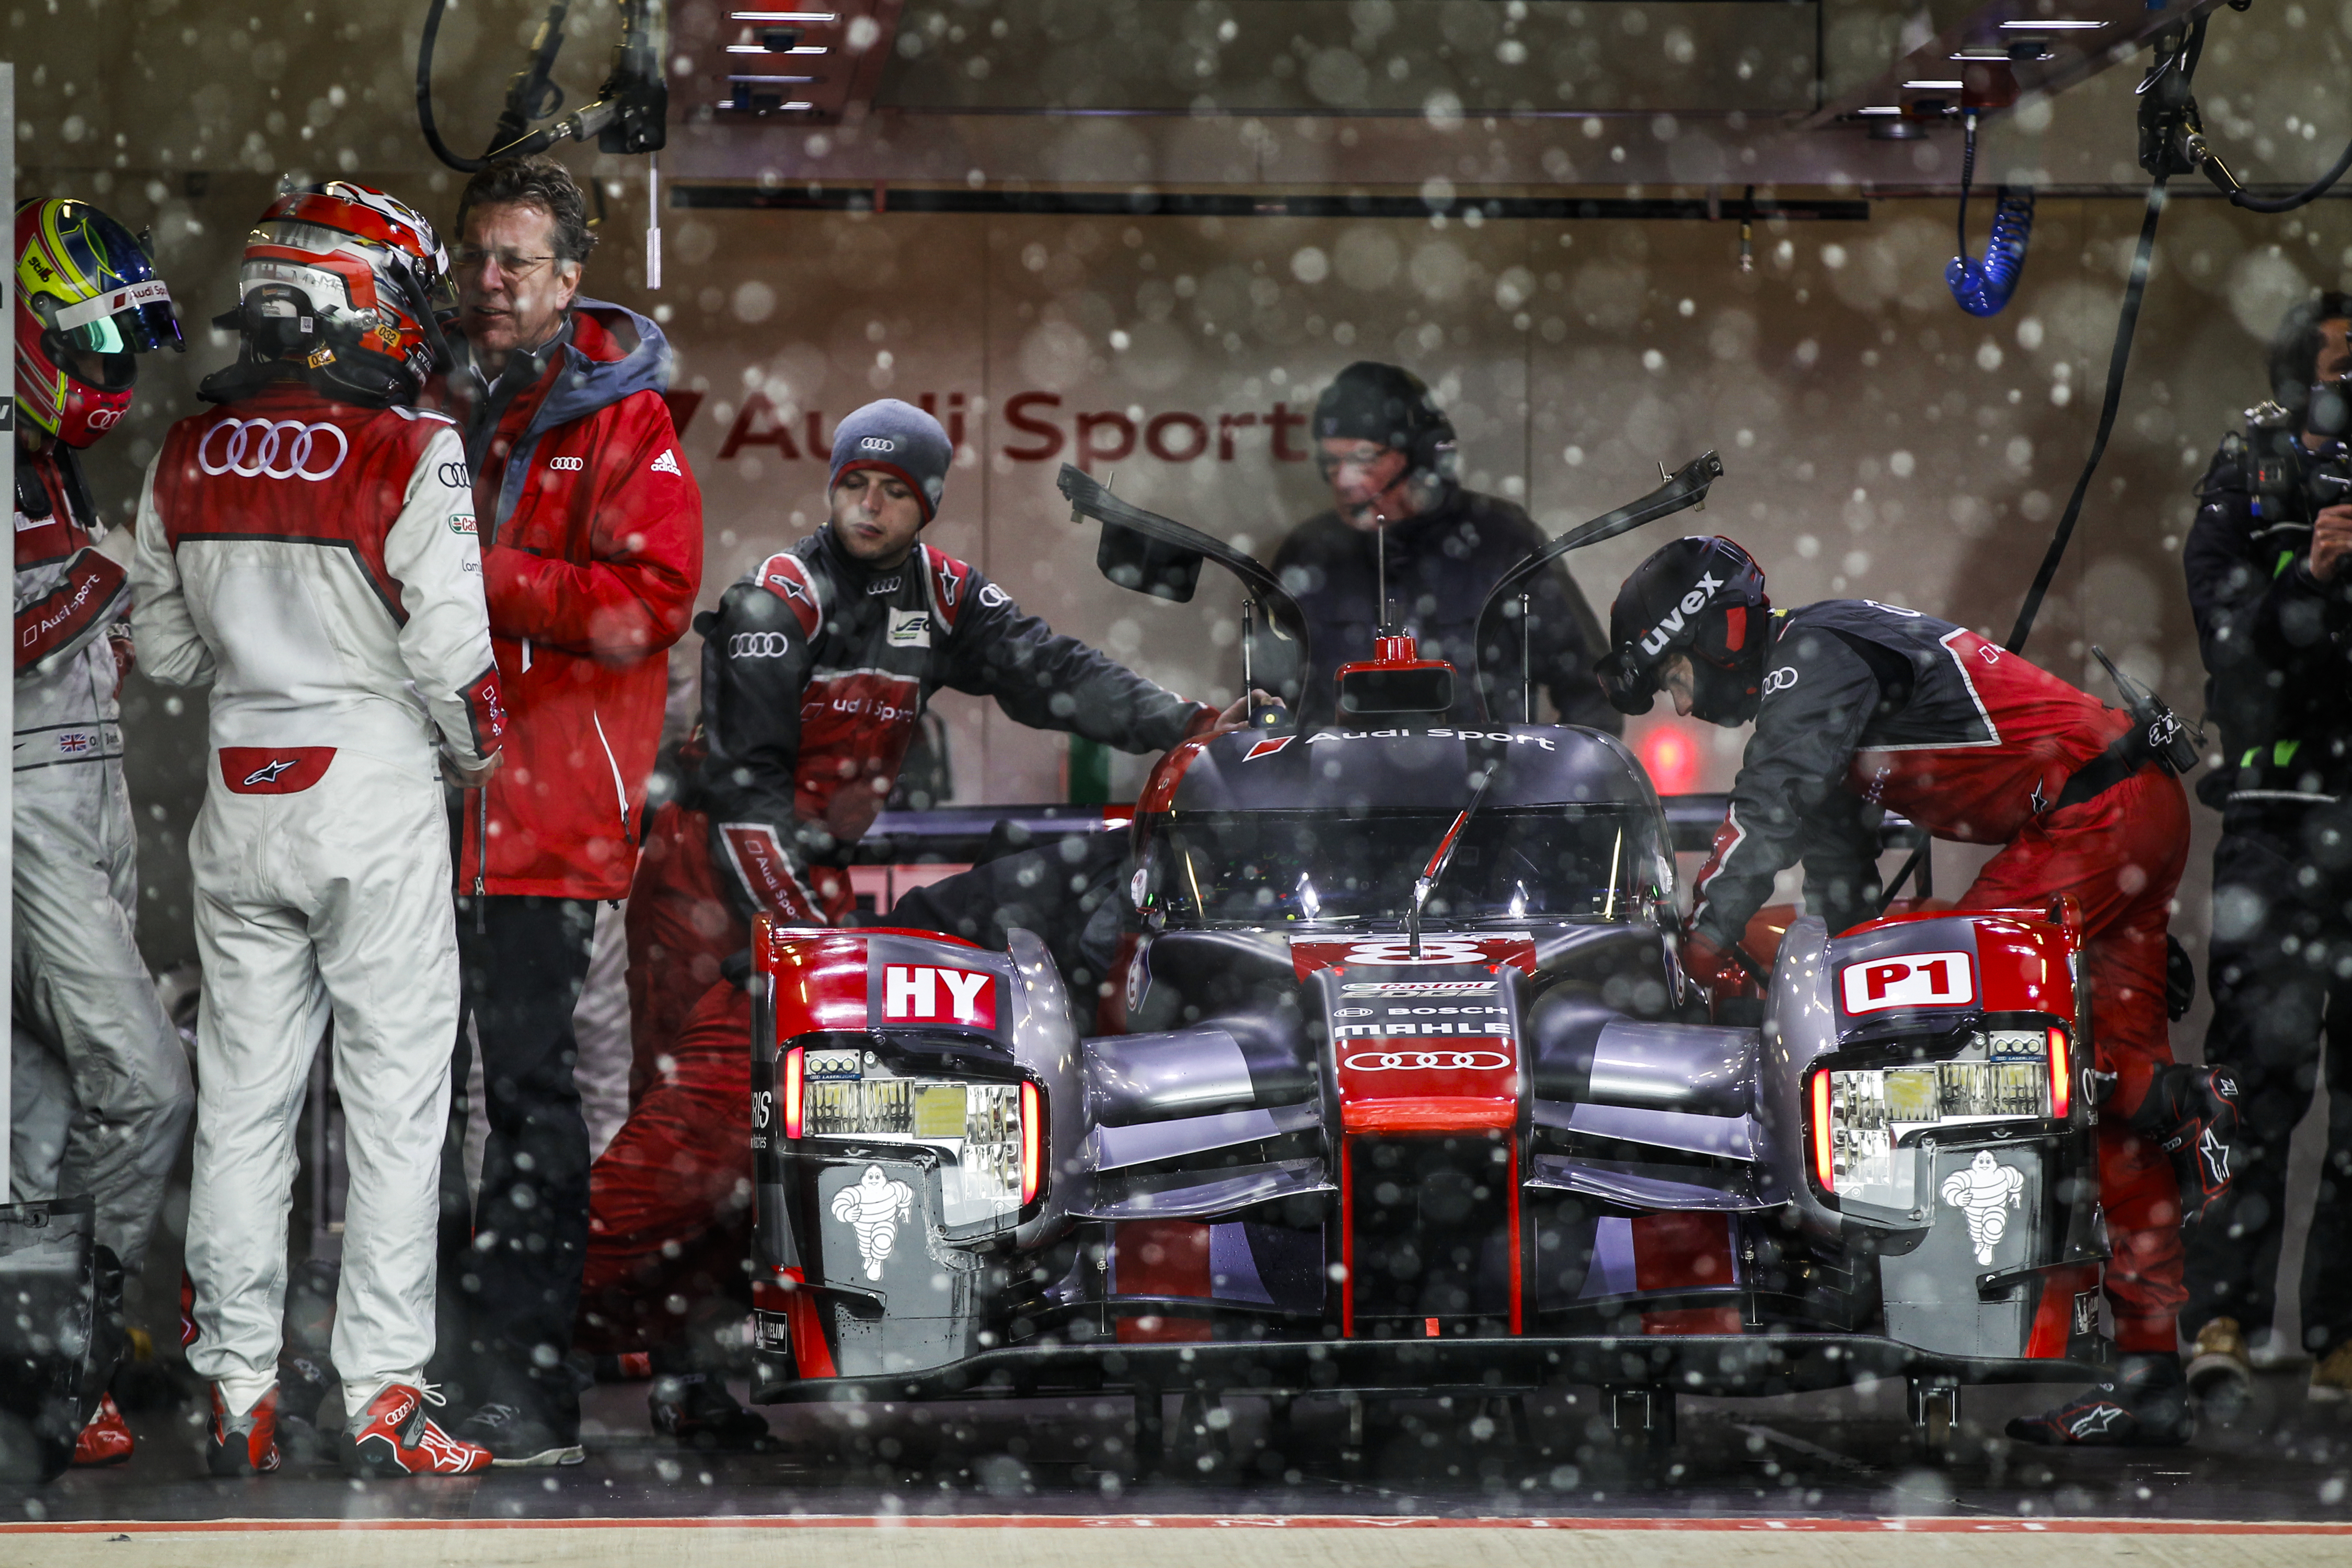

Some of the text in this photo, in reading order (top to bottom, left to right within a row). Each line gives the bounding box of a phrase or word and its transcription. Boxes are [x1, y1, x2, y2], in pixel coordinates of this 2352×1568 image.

[130, 287, 154, 301] Audi
[379, 326, 397, 344] 032
[717, 390, 1310, 474] Aui Sport
[650, 464, 682, 477] adidas
[40, 605, 71, 633] Audi
[1640, 570, 1724, 656] uvex
[1305, 728, 1555, 751] Audi Sport
[756, 857, 780, 890] Audi
[1344, 942, 1488, 965] 8
[887, 966, 989, 1018] HY
[1865, 960, 1951, 1001] P1
[1338, 990, 1502, 999] EDGE
[1388, 1006, 1509, 1016] BOSCH
[1334, 1022, 1512, 1038] MAHLE
[751, 1090, 772, 1128] RIS
